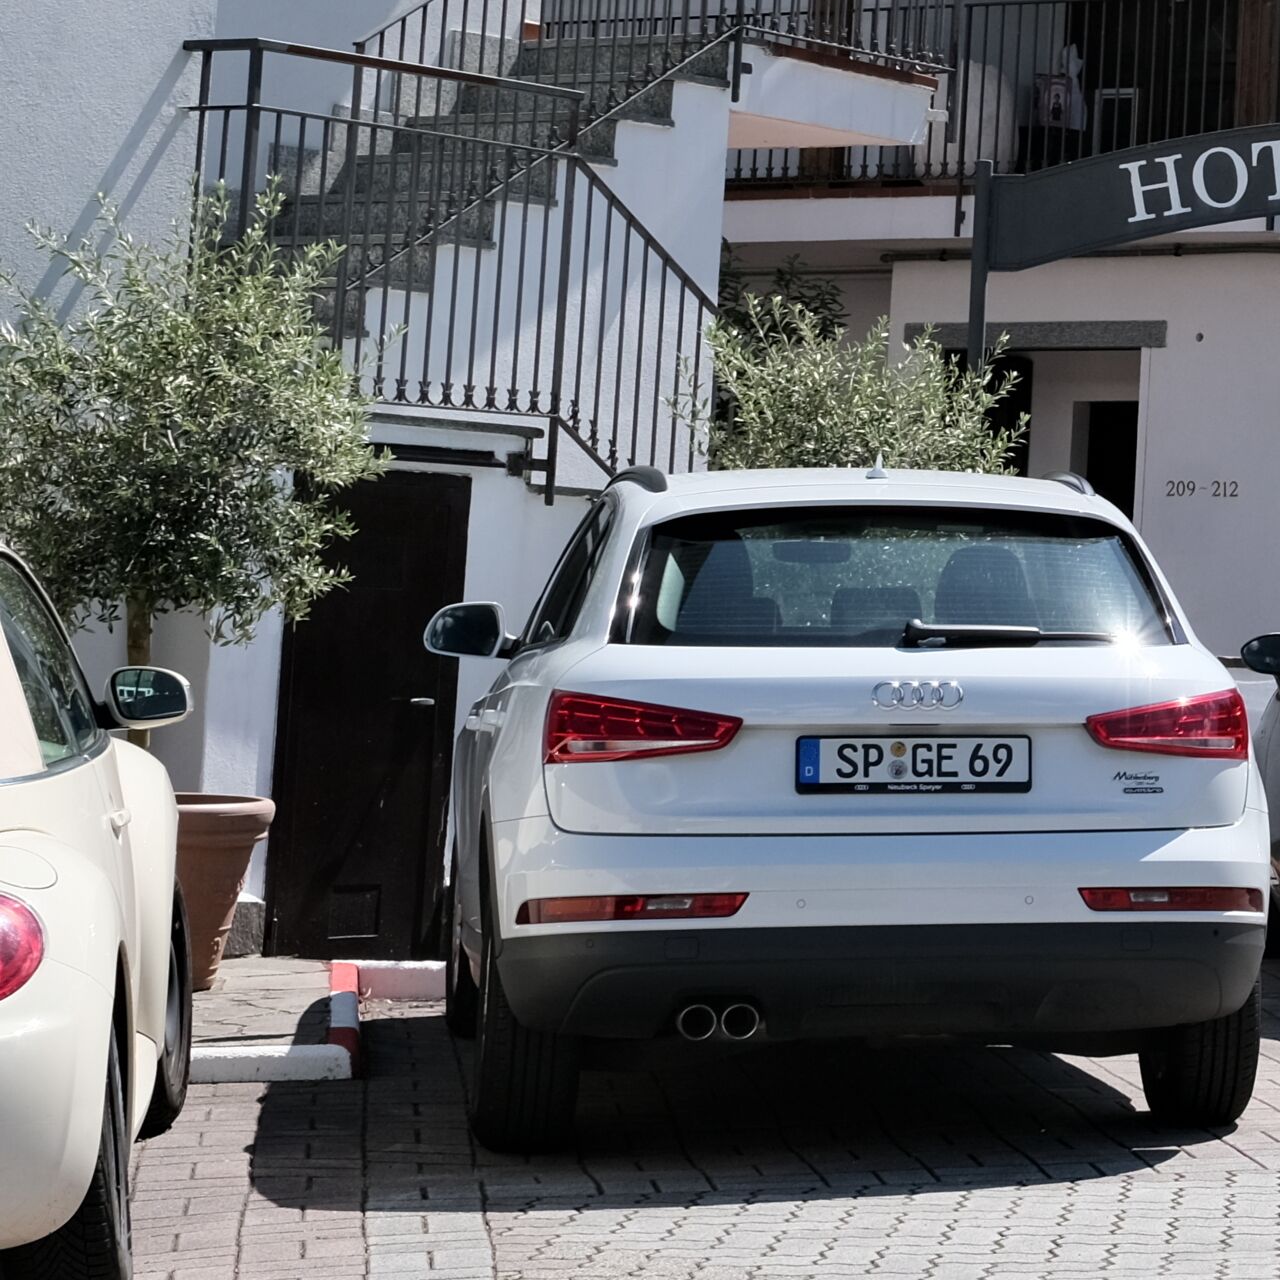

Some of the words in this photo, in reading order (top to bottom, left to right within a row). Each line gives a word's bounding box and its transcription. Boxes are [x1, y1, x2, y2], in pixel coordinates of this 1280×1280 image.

[805, 766, 814, 776] D
[835, 743, 884, 779] SP
[911, 743, 959, 778] GE
[968, 743, 1013, 778] 69
